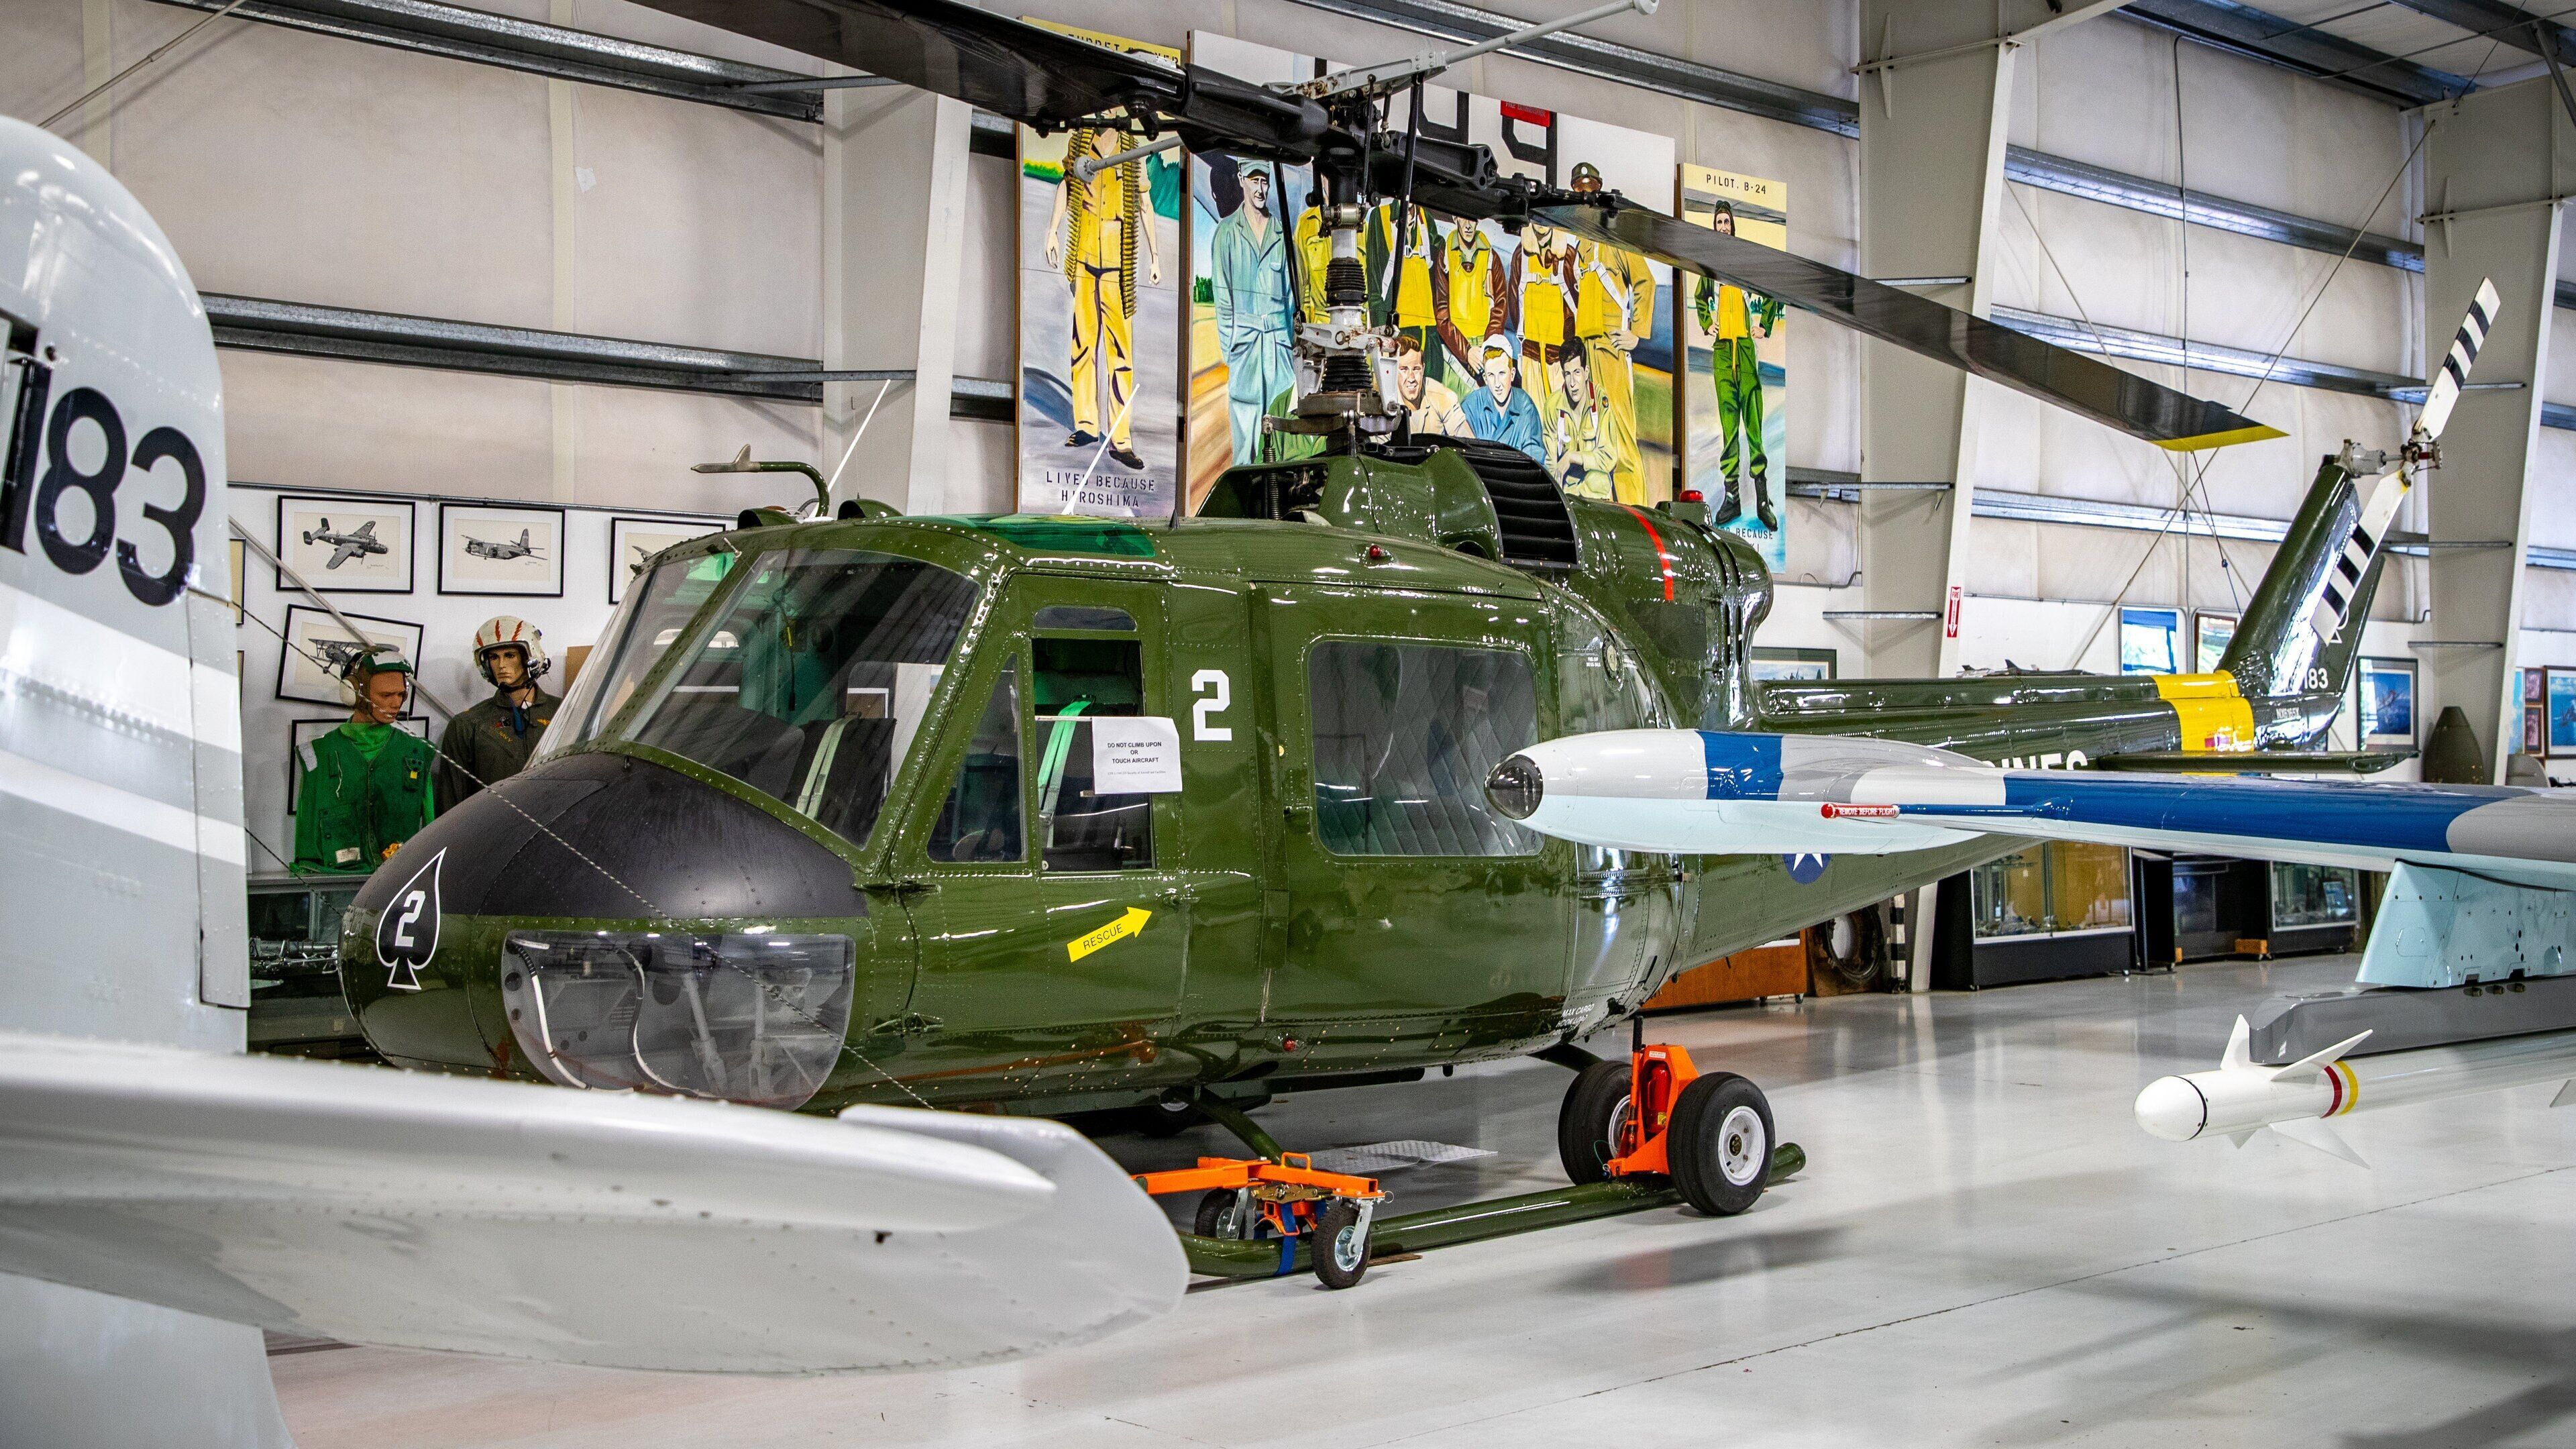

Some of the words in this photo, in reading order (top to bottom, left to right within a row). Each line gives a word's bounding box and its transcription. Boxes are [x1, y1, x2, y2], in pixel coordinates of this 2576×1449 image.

[1744, 182, 1766, 195] B-24
[1096, 475, 1155, 491] BECAUSE
[1735, 528, 1773, 539] BECAUSE
[2304, 667, 2328, 690] 183
[1191, 669, 1232, 741] 2
[1839, 808, 1858, 816] REMOVE
[1859, 808, 1877, 816] BEFORE
[1878, 808, 1895, 816] FLIGHT
[395, 890, 426, 947] 2
[1083, 923, 1123, 950] RESCUE
[1561, 1008, 1577, 1017] MAX
[1576, 1004, 1595, 1015] CARGO
[1556, 1018, 1574, 1028] HOOK
